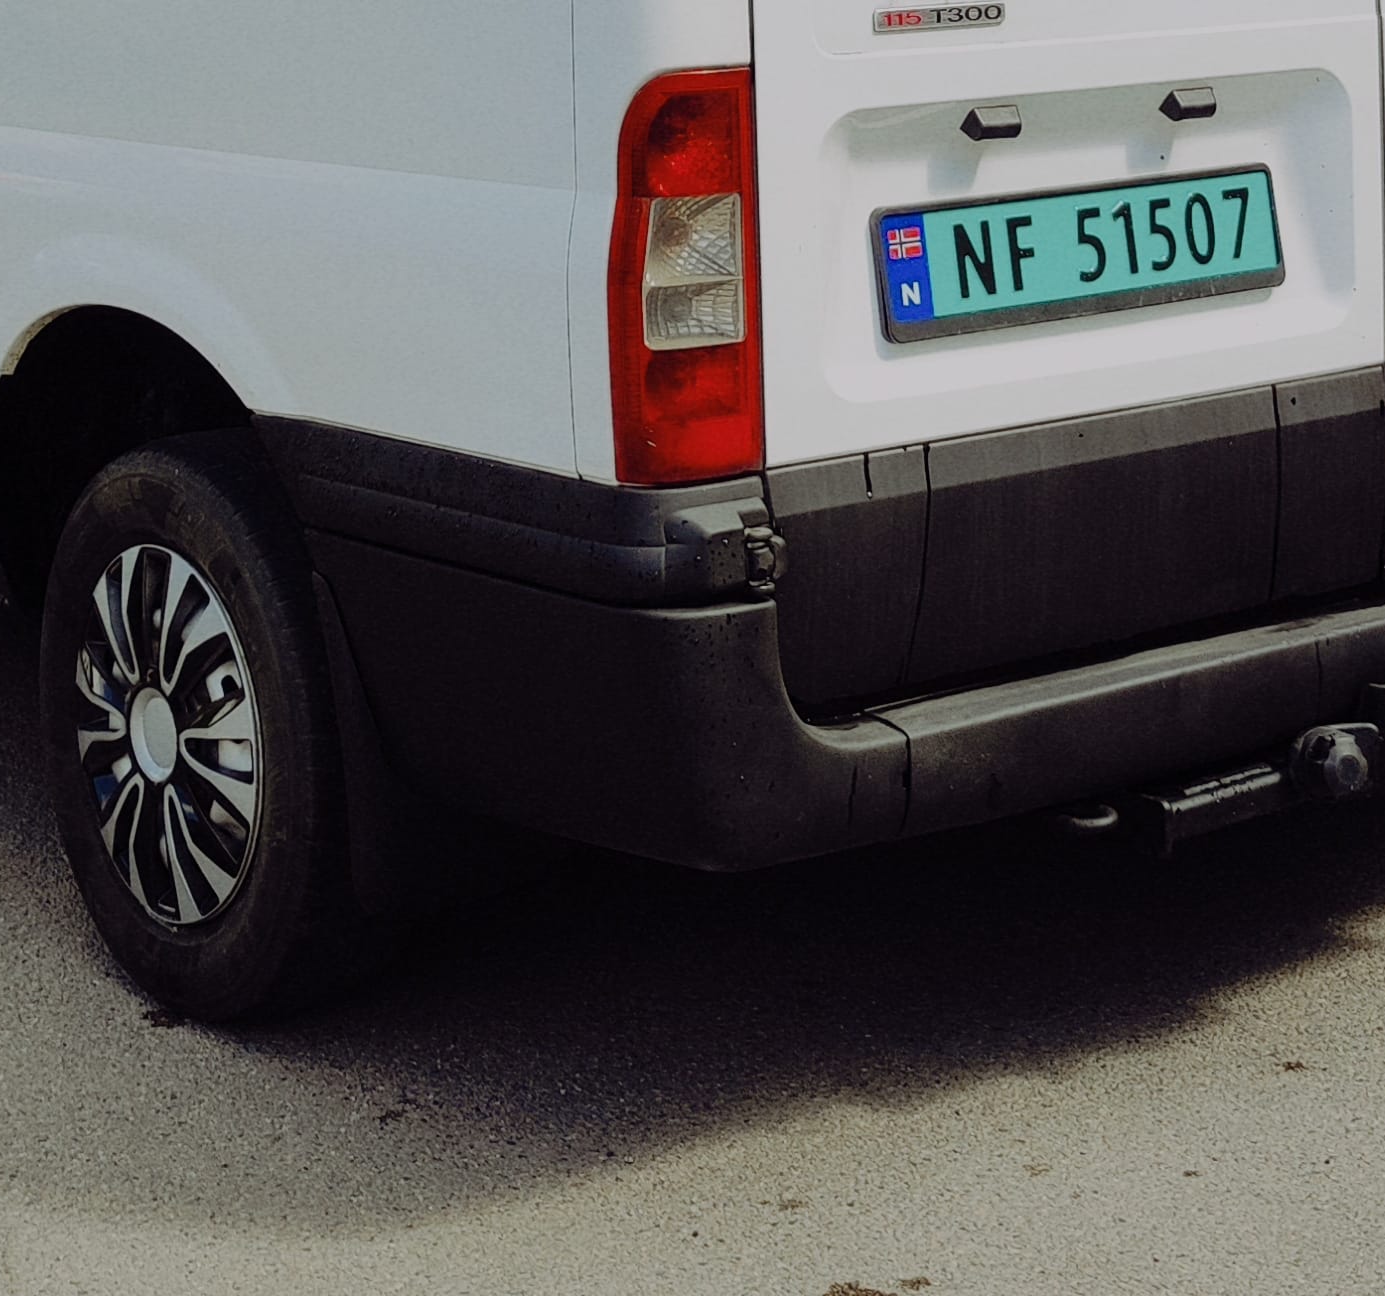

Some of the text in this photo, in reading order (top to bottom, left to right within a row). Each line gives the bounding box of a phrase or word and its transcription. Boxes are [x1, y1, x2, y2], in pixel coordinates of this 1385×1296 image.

[883, 5, 1002, 27] 115 T300
[952, 186, 1249, 299] NF 51507
[901, 281, 922, 307] N
